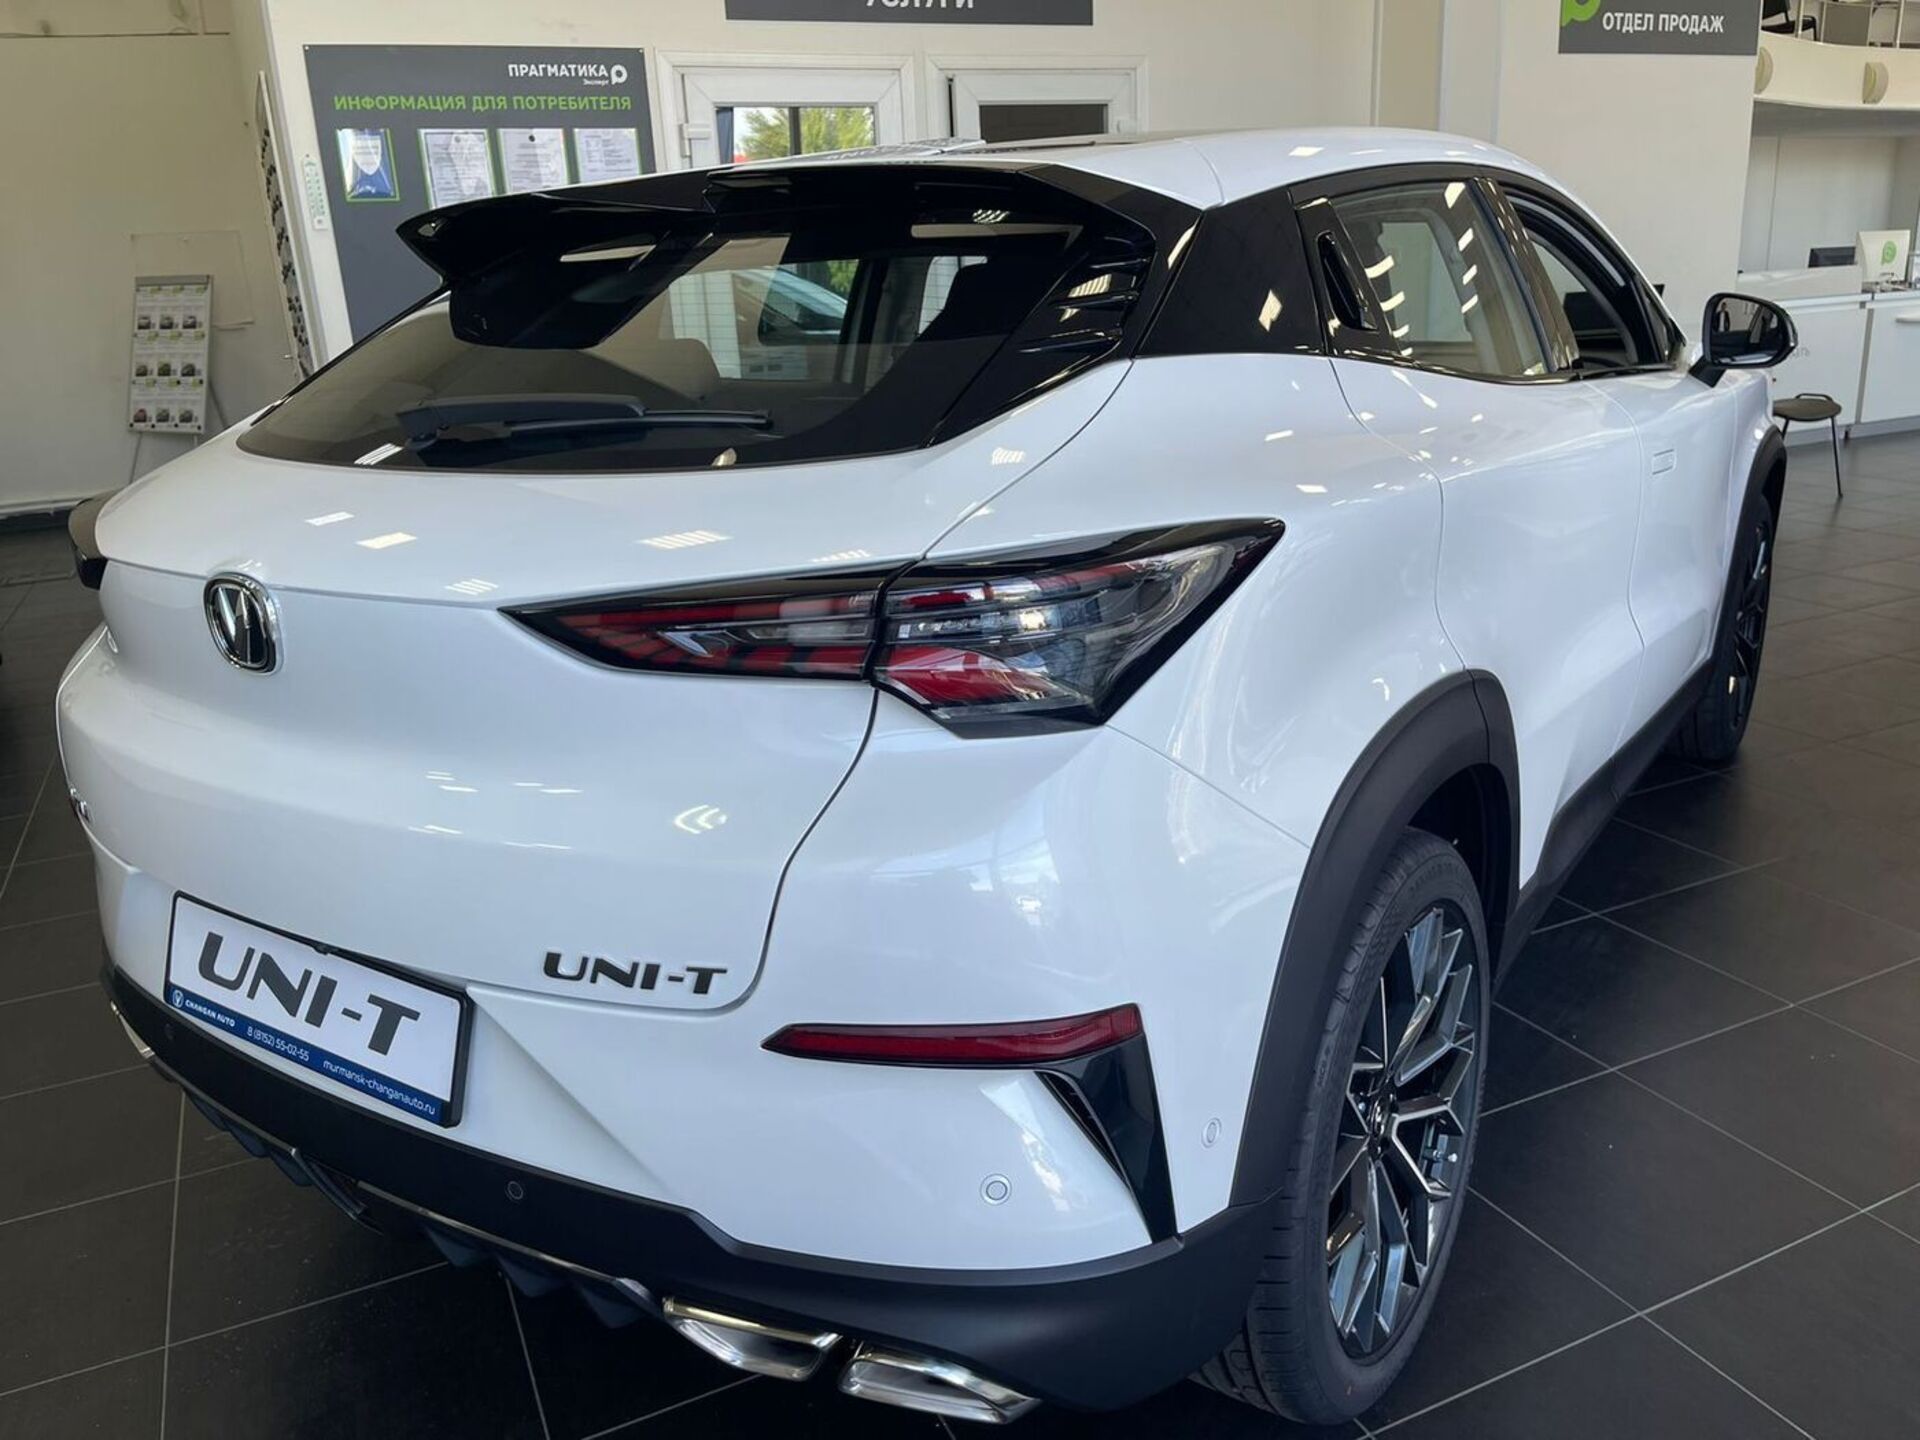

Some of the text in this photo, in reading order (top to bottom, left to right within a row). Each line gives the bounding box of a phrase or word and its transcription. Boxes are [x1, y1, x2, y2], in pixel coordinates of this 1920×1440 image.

[1602, 12, 1724, 35] ОТДЕЛ ПРОДАЖ
[507, 64, 609, 77] ПРАГМАТИКА
[334, 95, 632, 112] ИНФОРМАЦИЯ ДЛЯ ПОТРЕБИТЕЛЯ
[543, 951, 728, 995] UNI-T
[198, 931, 421, 1056] UNI-T
[185, 999, 236, 1027] CHANGAN AUTO
[246, 1026, 310, 1062] 8 (8152) 55-02-55
[322, 1060, 436, 1116] murmansk-changanauto.ru
